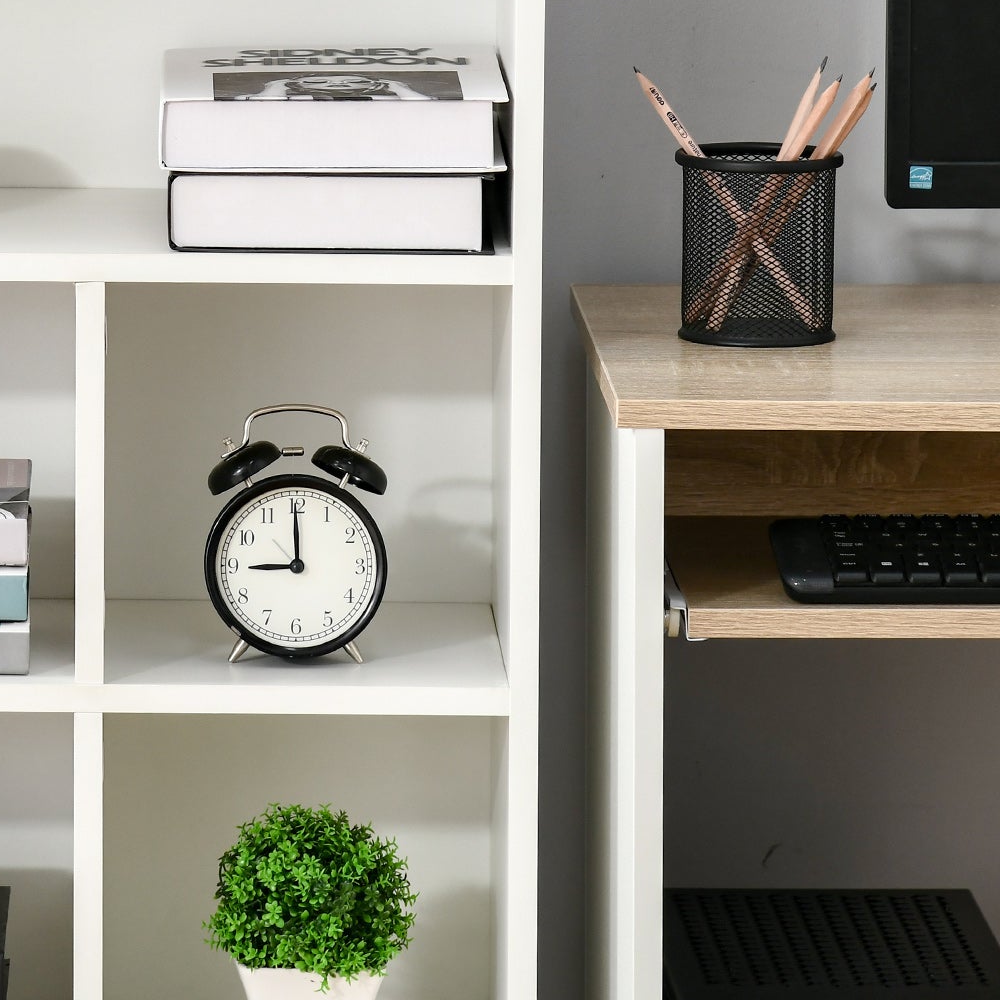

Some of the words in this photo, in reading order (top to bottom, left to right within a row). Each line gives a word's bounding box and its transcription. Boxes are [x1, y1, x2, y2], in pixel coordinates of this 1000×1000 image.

[239, 47, 431, 58] SIDNEY
[202, 57, 468, 68] SHELDON
[289, 497, 306, 514] 12
[260, 507, 274, 524] 11
[323, 506, 330, 523] 1
[239, 529, 255, 546] 10
[345, 527, 355, 544] 2
[227, 557, 239, 574] 9
[355, 558, 365, 575] 3
[237, 587, 249, 604] 8
[343, 587, 355, 604] 4
[262, 609, 272, 626] 7
[322, 611, 333, 627] 5
[290, 618, 302, 635] 6
